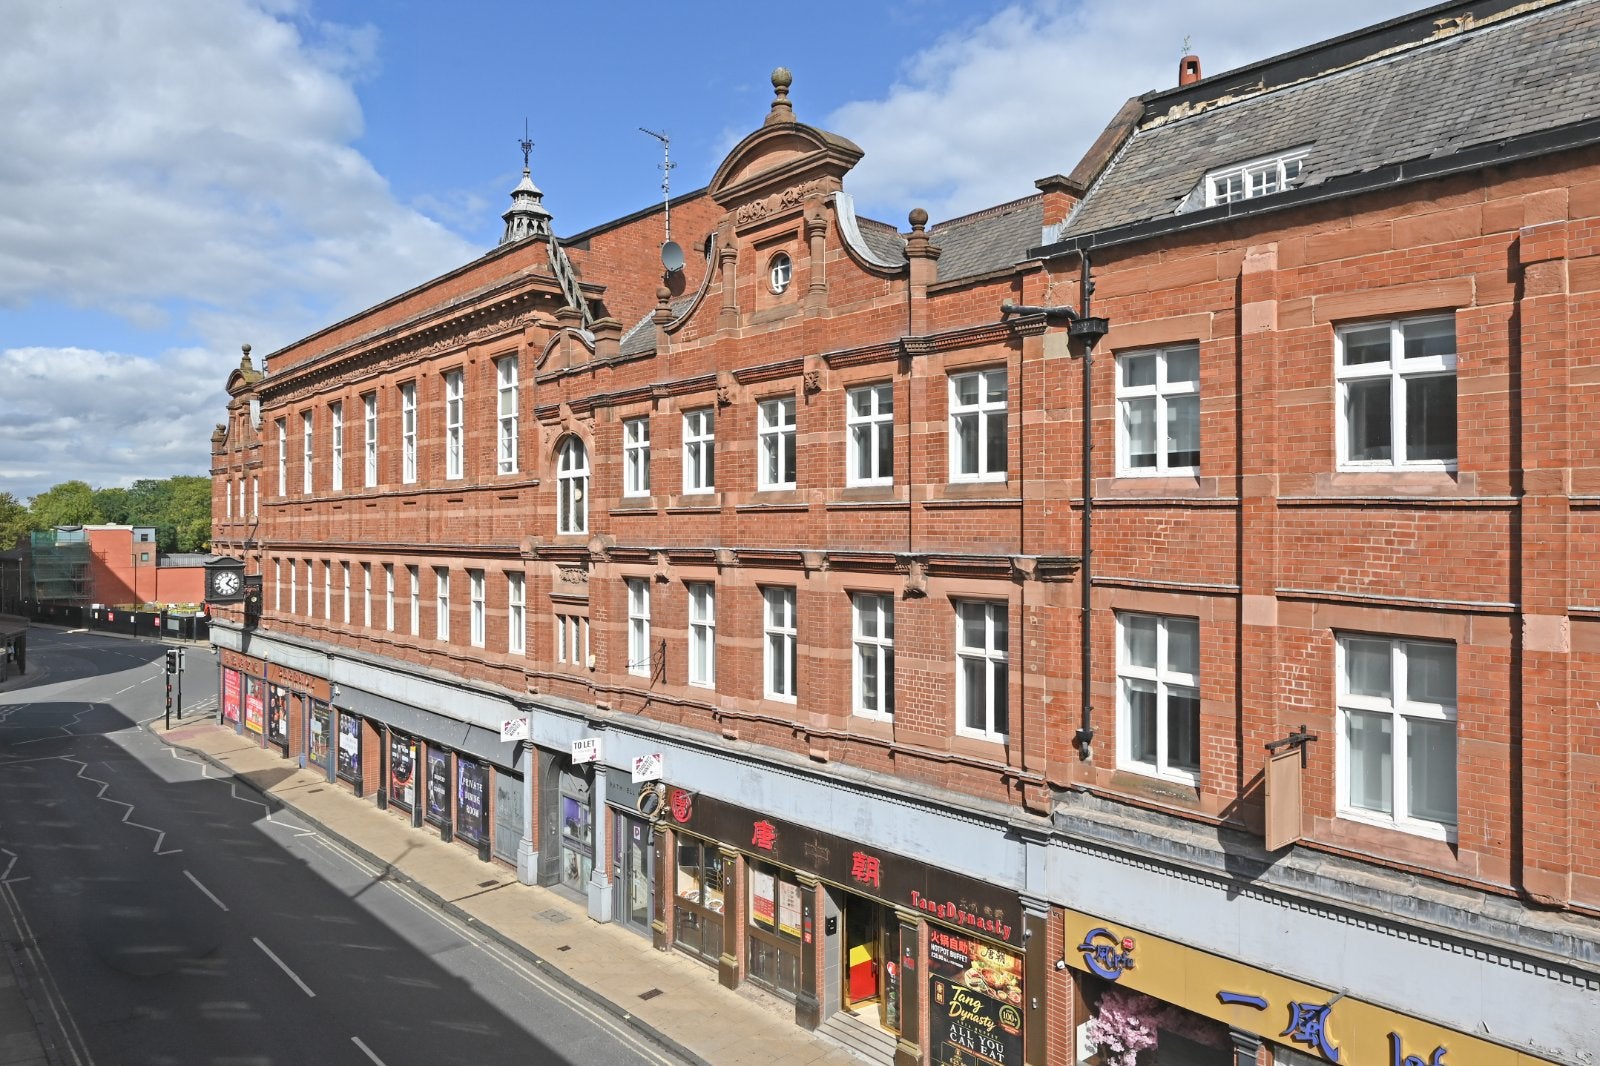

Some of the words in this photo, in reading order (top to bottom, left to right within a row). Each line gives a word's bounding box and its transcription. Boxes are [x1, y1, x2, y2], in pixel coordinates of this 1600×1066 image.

[584, 740, 594, 748] LET
[463, 777, 483, 792] PRIVATE
[465, 791, 481, 806] DINING
[466, 804, 479, 818] ROOM
[931, 943, 949, 956] HOTPOT
[950, 950, 968, 963] BUFFET
[951, 985, 984, 1012] Tang
[948, 1001, 996, 1032] Dynasty
[949, 1024, 974, 1041] ALL
[979, 1035, 1004, 1054] YOU
[949, 1033, 975, 1050] CAN
[980, 1045, 1005, 1062] EAT
